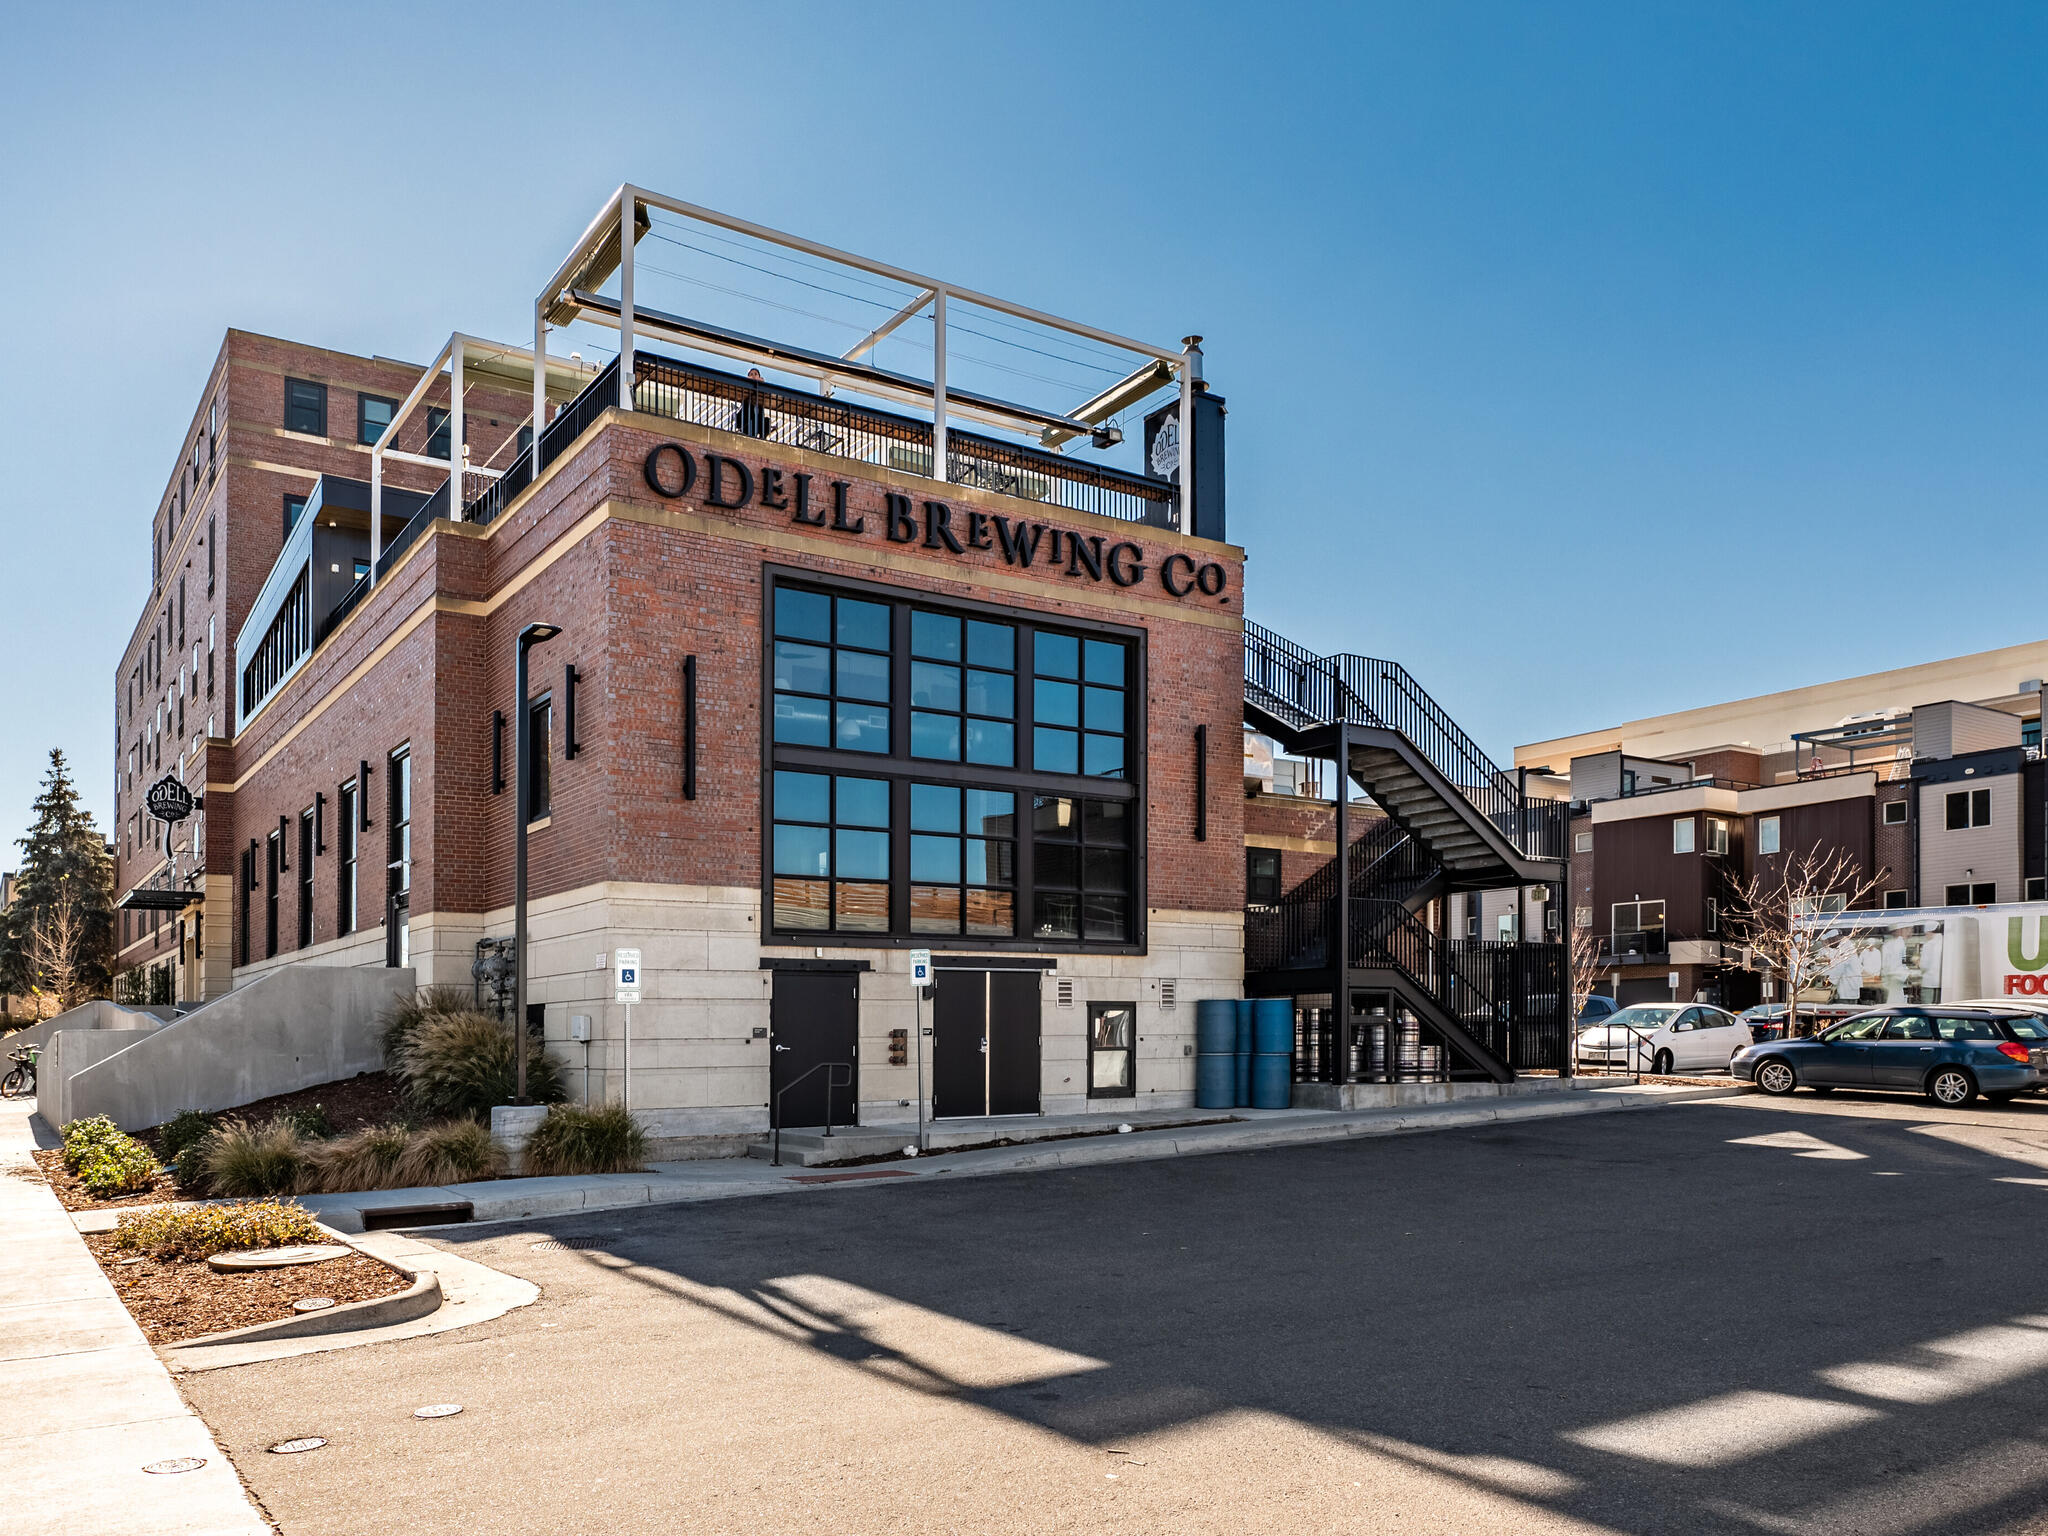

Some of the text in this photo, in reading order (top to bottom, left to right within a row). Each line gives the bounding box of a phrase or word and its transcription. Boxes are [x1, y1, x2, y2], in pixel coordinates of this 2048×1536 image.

[644, 443, 864, 534] ODELL
[885, 492, 1148, 588] BREWING
[152, 782, 188, 805] ODELL
[153, 801, 187, 812] BREWING
